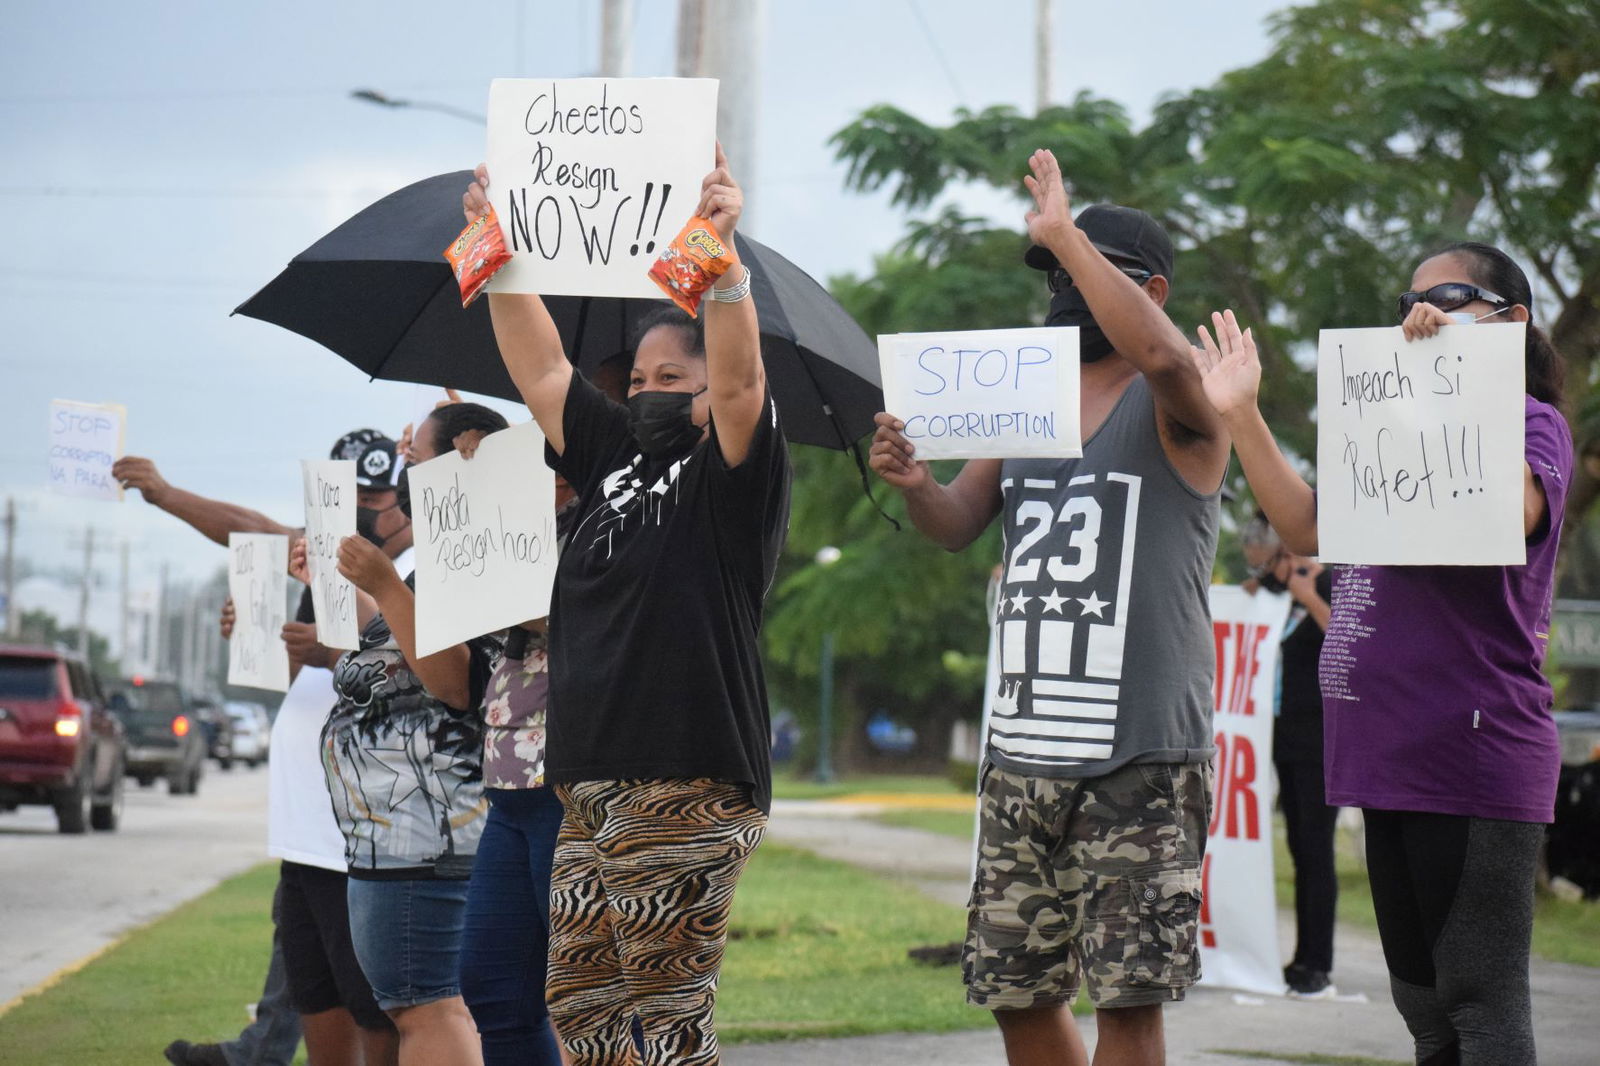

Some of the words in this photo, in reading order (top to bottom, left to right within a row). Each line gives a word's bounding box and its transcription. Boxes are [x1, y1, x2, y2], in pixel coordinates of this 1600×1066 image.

[524, 83, 643, 135] Cheetos
[532, 141, 619, 209] Resign
[509, 182, 672, 265] NOW!!
[915, 346, 1052, 396] STOP
[1338, 344, 1414, 419] Impeach
[53, 411, 112, 437] STOP
[903, 410, 1057, 440] CORRUPTION
[423, 472, 471, 545] Basta
[436, 527, 498, 583] Resign
[1006, 496, 1103, 584] 23
